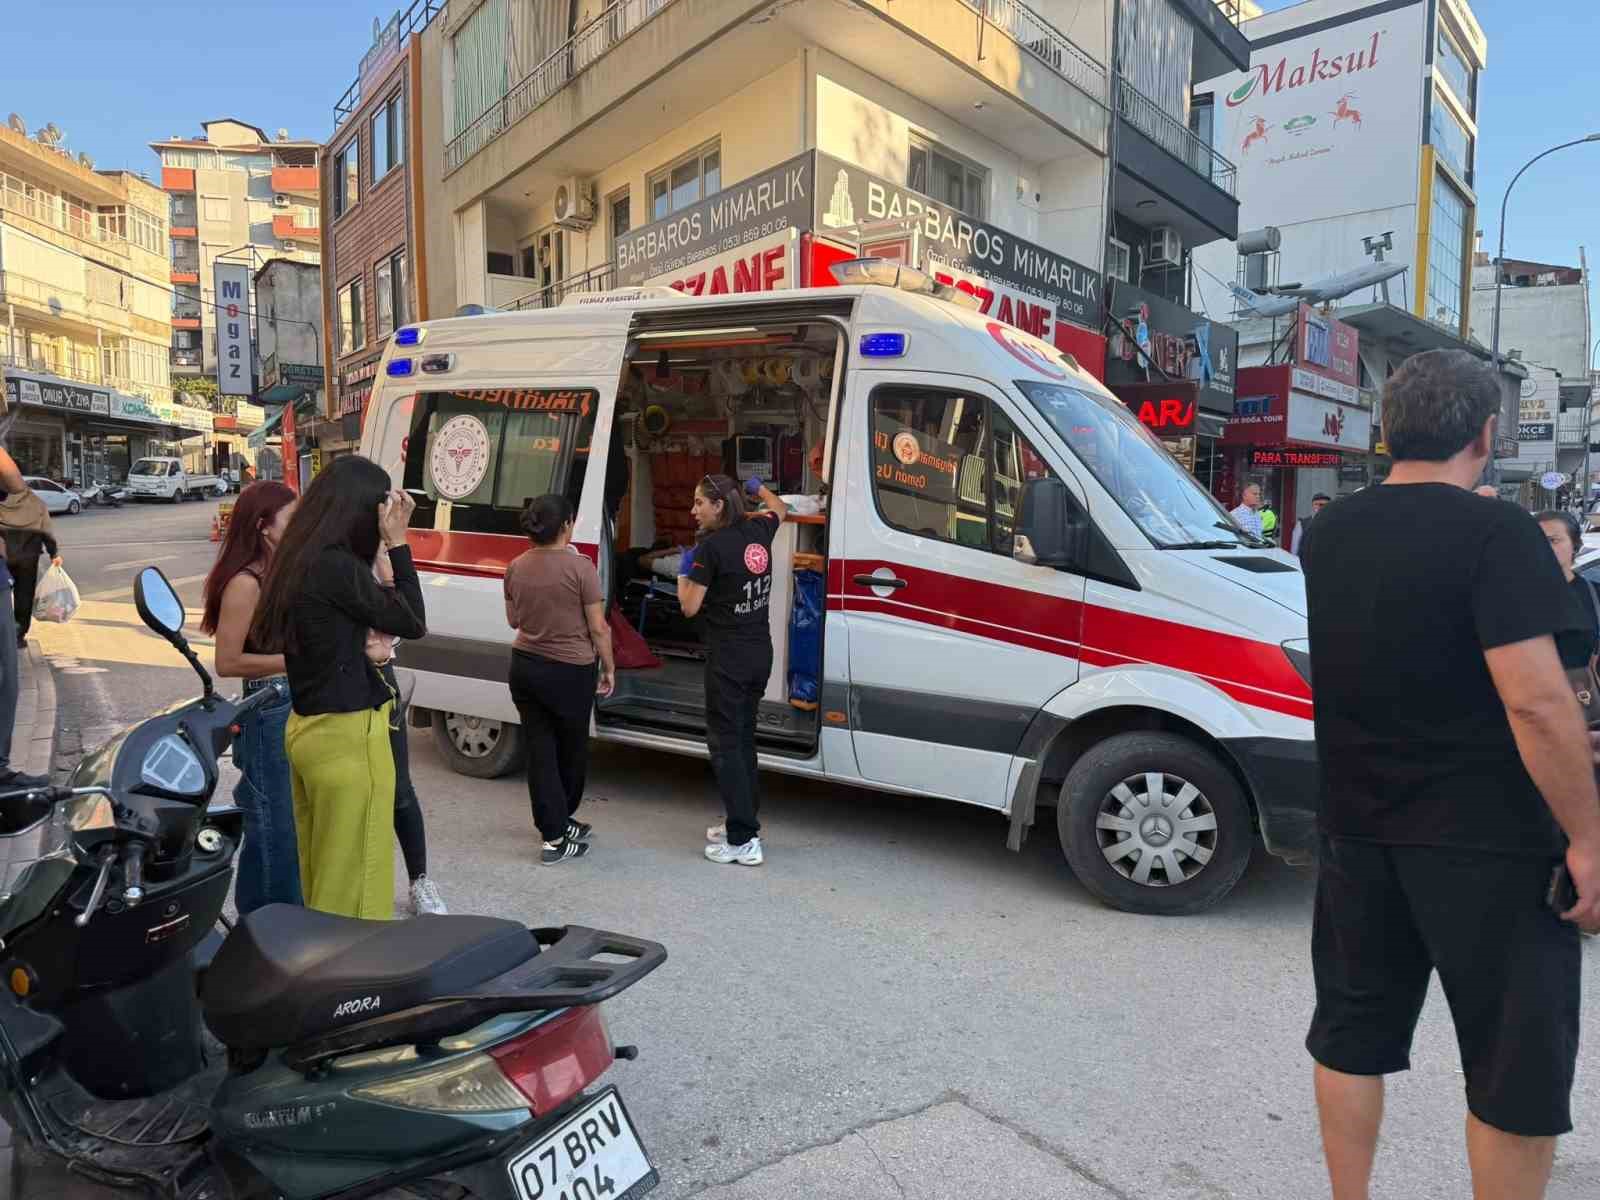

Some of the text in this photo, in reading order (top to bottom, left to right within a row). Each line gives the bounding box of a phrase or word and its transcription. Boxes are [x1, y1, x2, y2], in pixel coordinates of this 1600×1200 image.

[1248, 30, 1381, 97] Maksul
[617, 212, 701, 270] BARBAROS
[868, 181, 1004, 266] BARBAROS
[743, 574, 771, 599] 112
[333, 995, 380, 1018] ARORA
[521, 1145, 558, 1200] 07
[563, 1101, 621, 1169] BRV
[560, 1163, 615, 1200] 04
